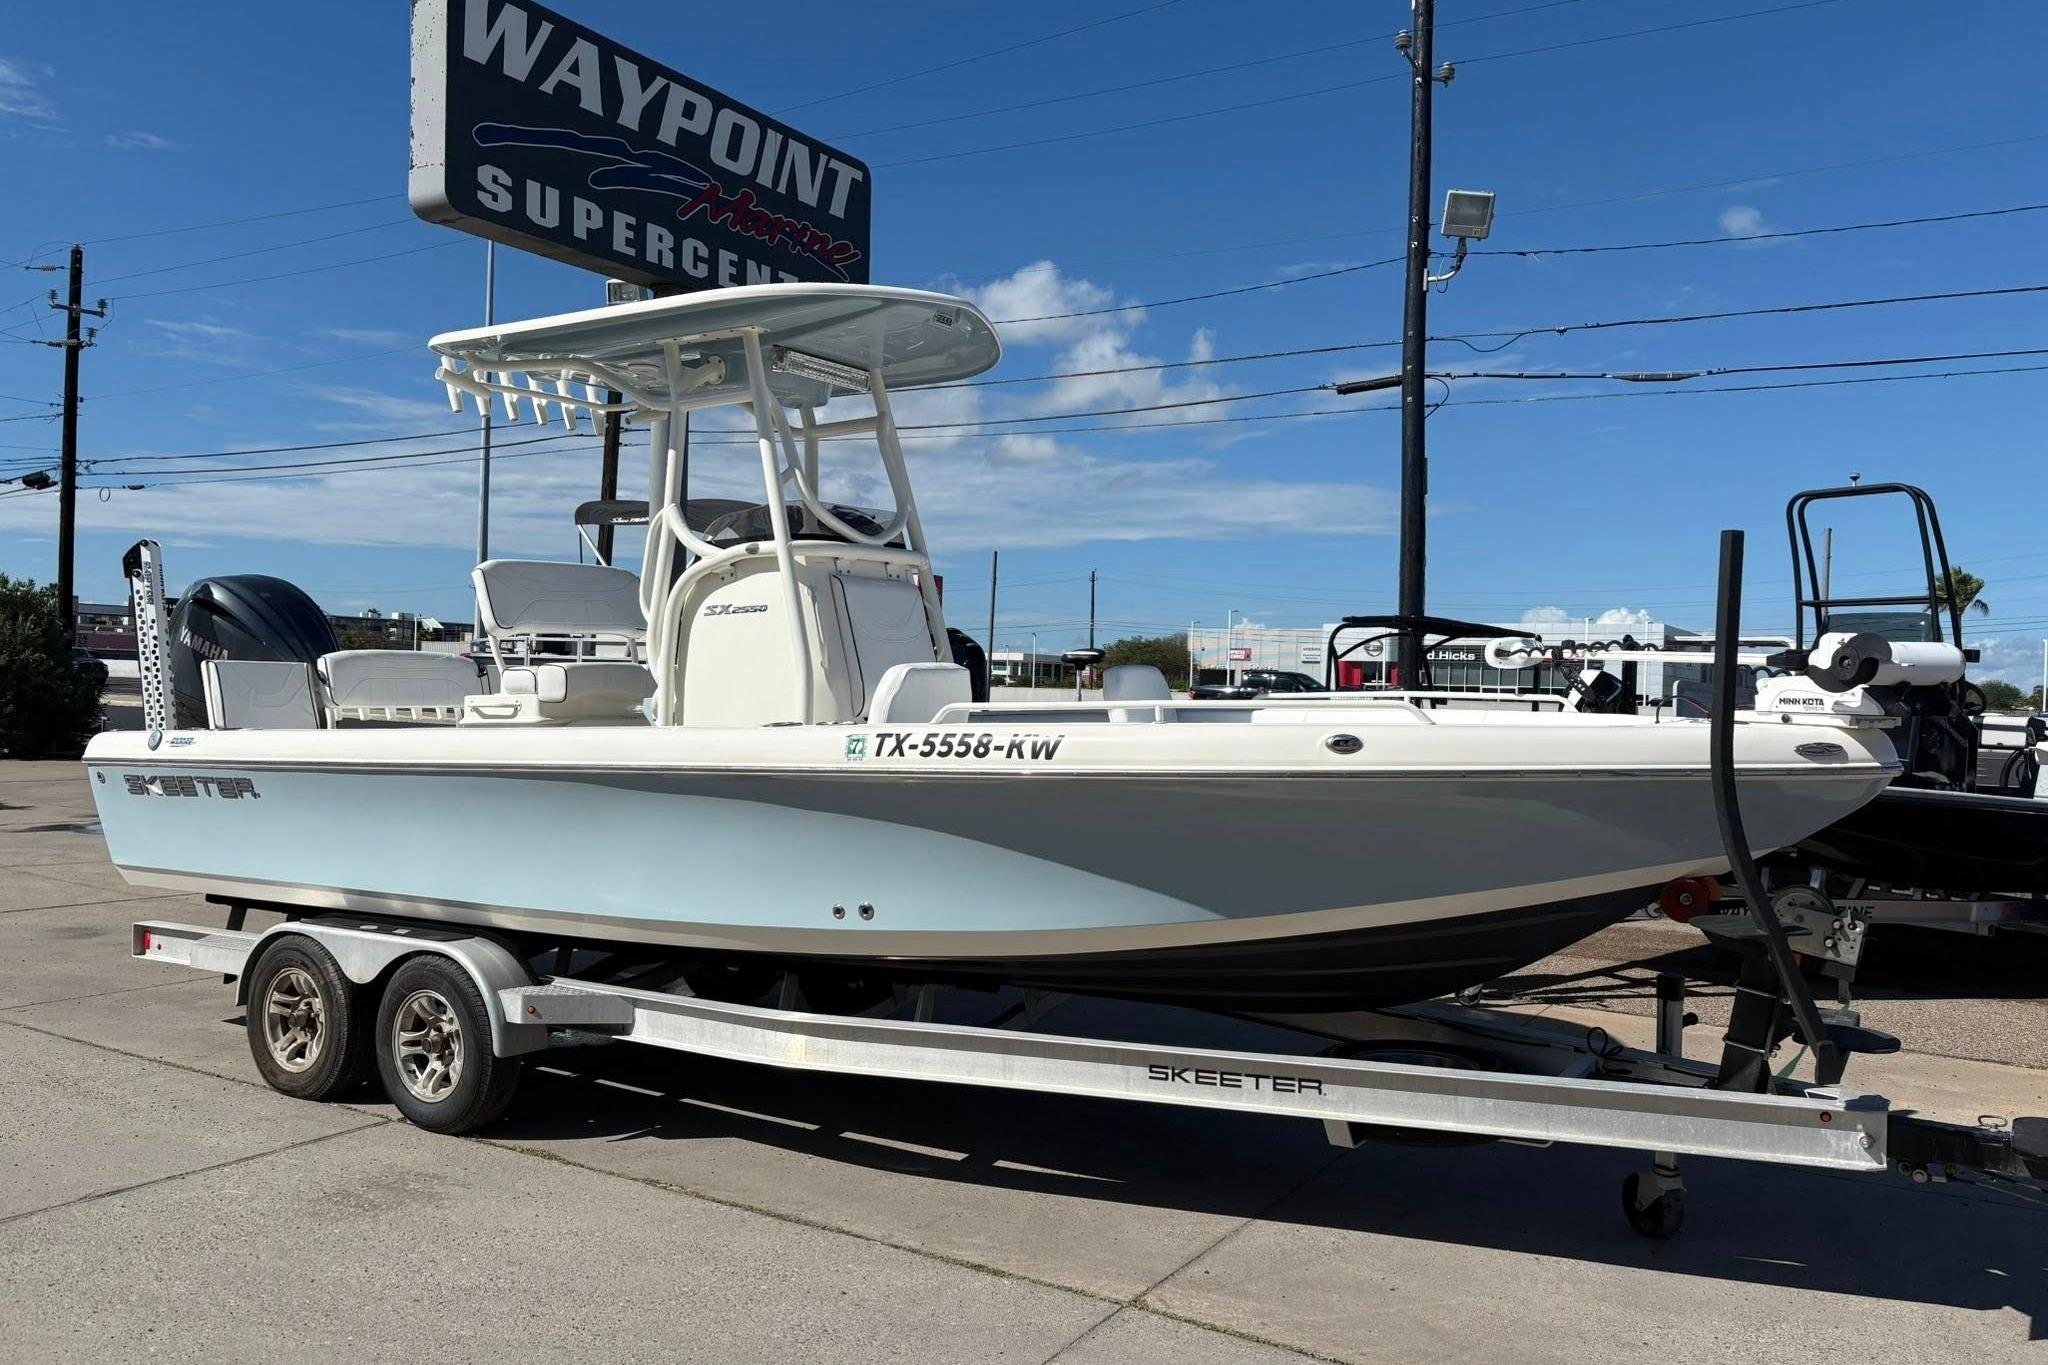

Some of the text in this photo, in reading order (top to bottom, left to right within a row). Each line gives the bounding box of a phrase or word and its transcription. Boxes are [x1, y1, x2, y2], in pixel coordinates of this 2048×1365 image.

[463, 0, 863, 219] WAYPOINT
[677, 182, 862, 264] Marine
[180, 625, 228, 660] YAMAHA
[1426, 650, 1476, 660] d Hicks
[1779, 697, 1824, 706] MINN KOTA
[852, 738, 861, 754] 7
[874, 733, 1065, 760] TX-5558-KW
[123, 774, 258, 799] SKEETER
[1148, 1064, 1323, 1096] SKEETER
